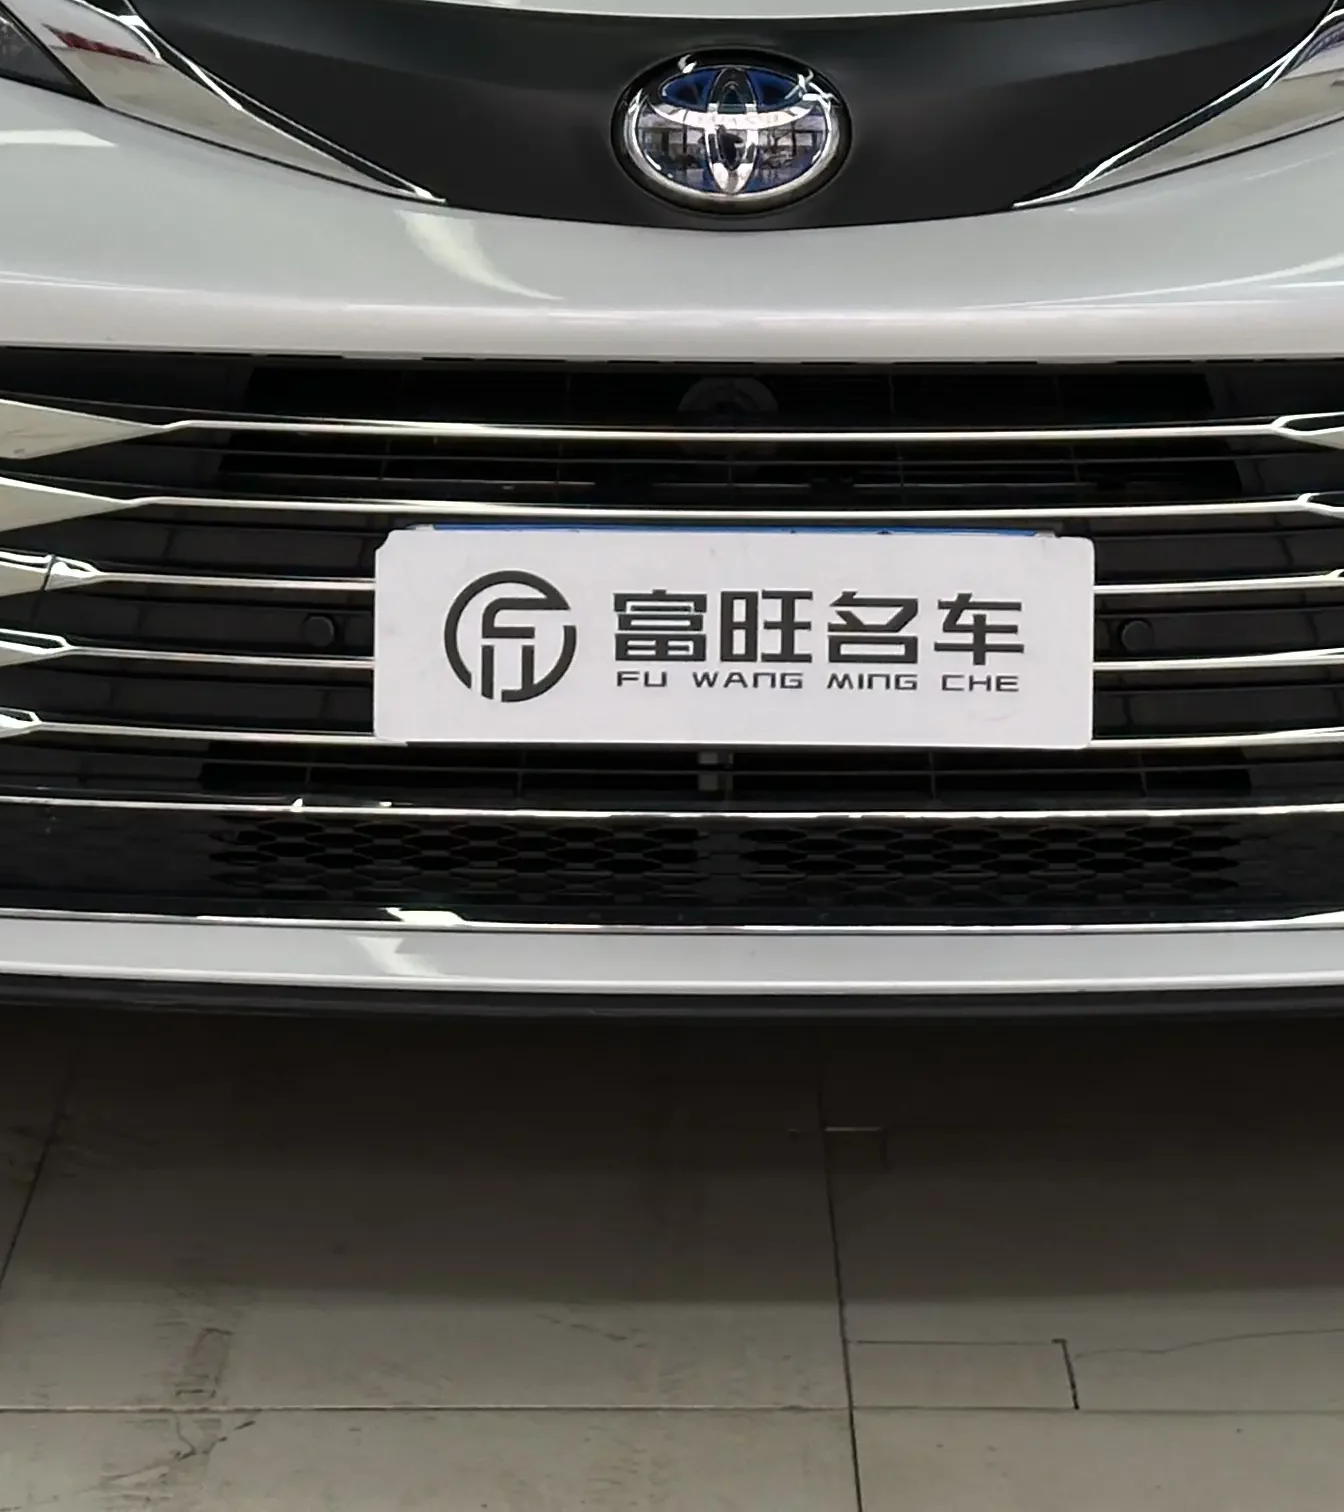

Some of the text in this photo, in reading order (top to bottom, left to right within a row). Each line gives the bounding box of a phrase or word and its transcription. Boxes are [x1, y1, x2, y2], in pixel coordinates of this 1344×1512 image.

[613, 588, 1025, 666] 富旺名车
[616, 670, 1020, 693] FU WANG MING CHE
